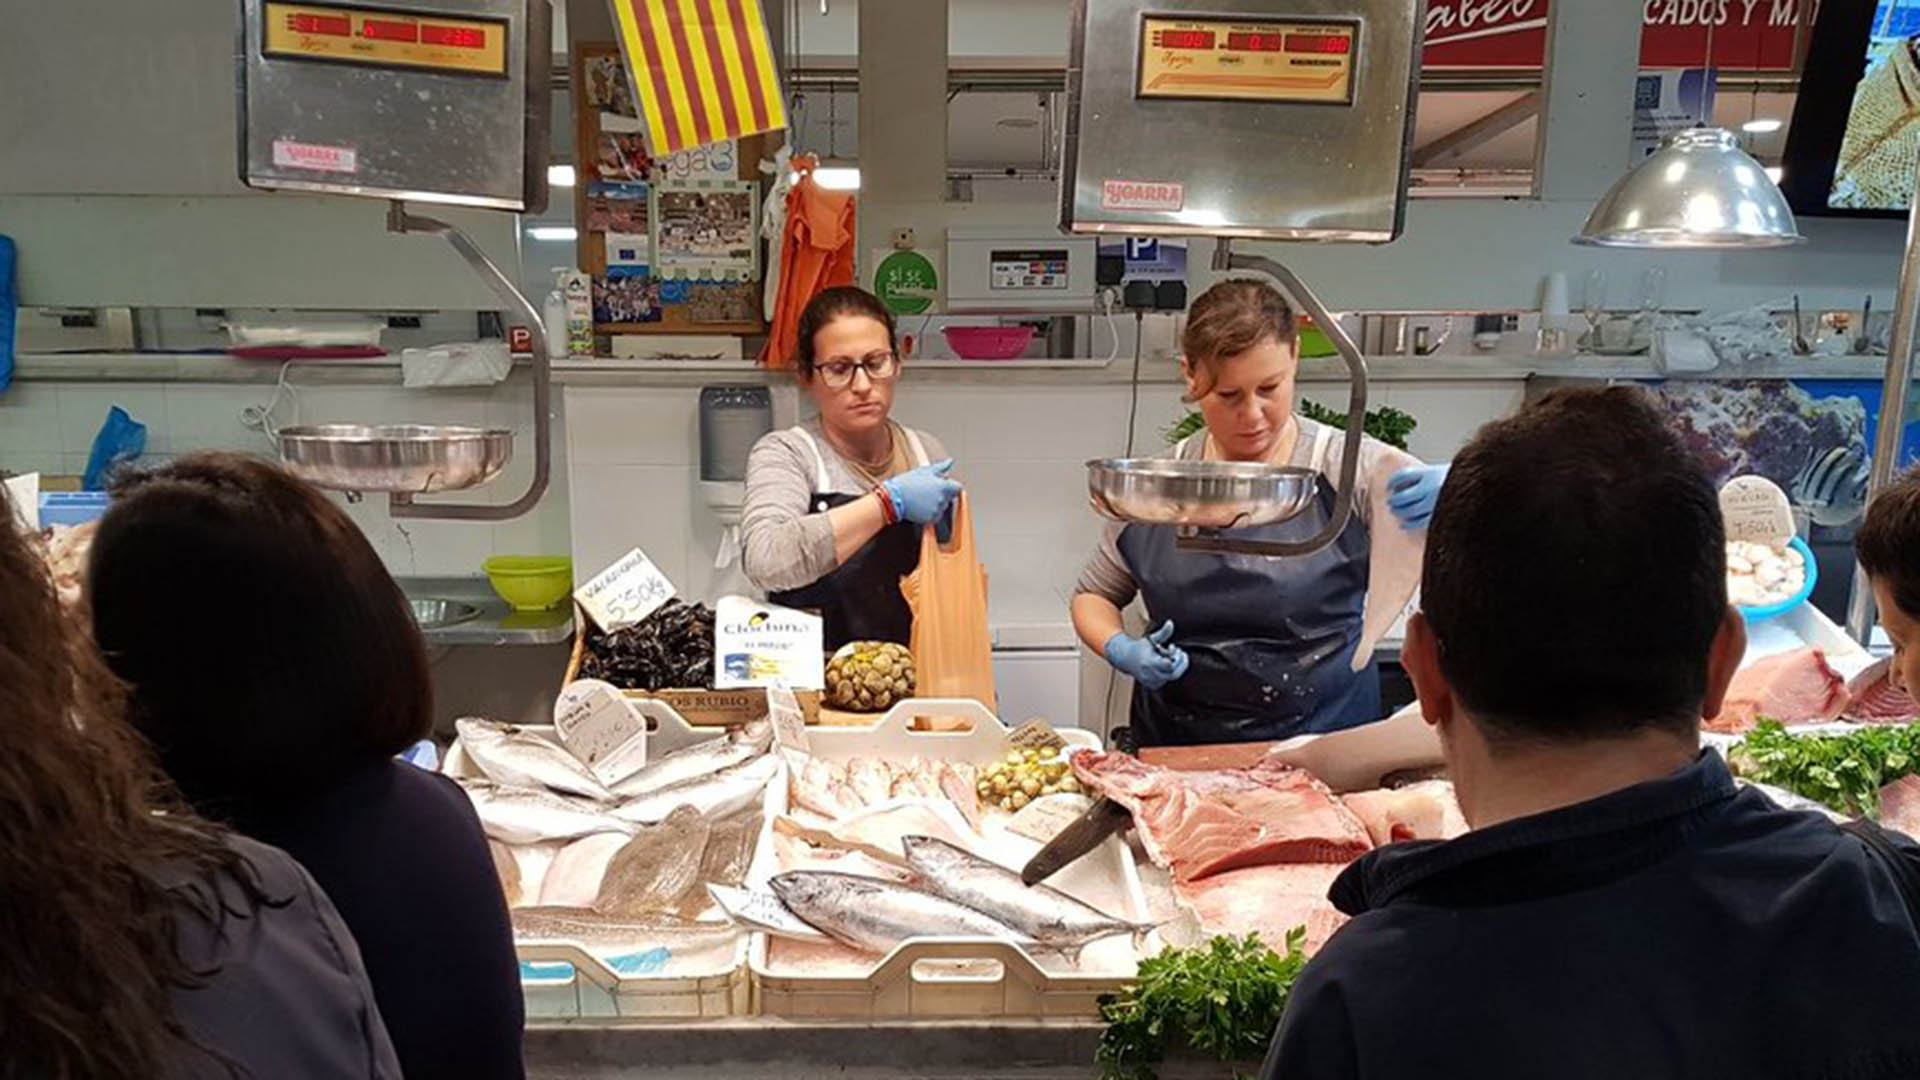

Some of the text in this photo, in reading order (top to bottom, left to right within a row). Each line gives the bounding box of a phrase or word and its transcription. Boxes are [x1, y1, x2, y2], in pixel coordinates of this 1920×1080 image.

[1742, 0, 1759, 25] Y
[1106, 184, 1179, 204] YGARRA
[1132, 236, 1153, 259] P
[513, 328, 530, 345] P
[696, 695, 749, 706] RUBIO
